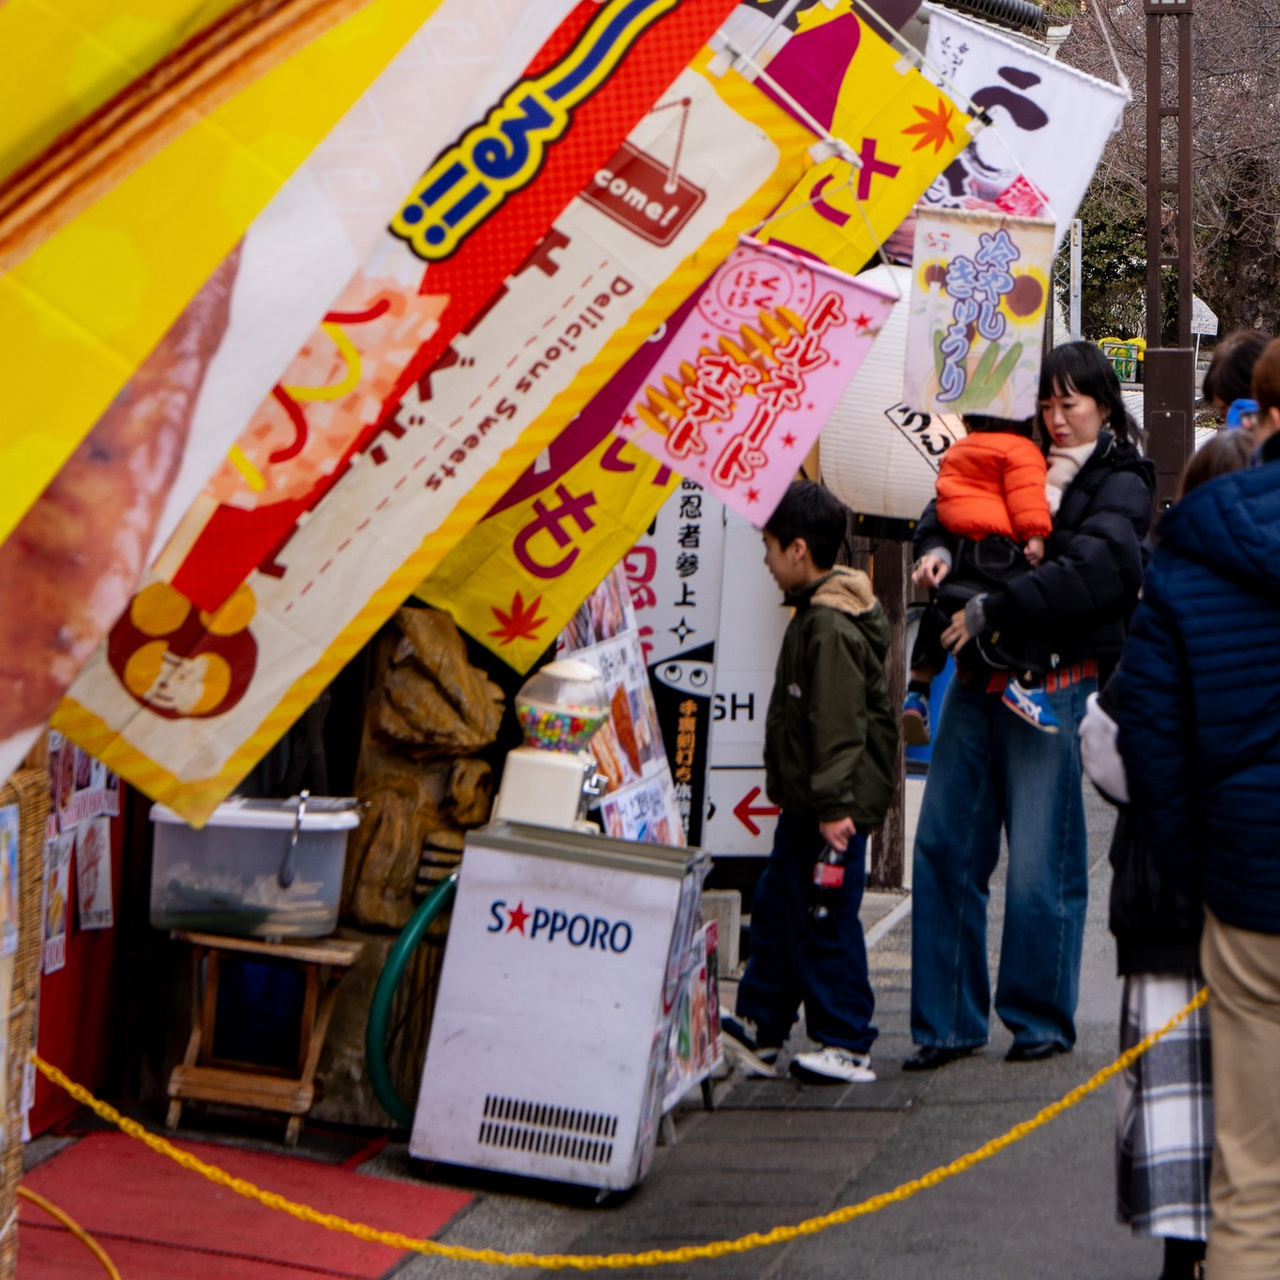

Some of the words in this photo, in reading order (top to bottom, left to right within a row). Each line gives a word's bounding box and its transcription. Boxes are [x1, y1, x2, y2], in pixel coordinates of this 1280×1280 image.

[595, 168, 679, 226] come!
[515, 274, 634, 397] Delicious
[936, 256, 982, 402] きゅうり
[975, 230, 1021, 340] 冷やし
[665, 355, 759, 459] ポテト
[712, 292, 846, 487] トルネード
[897, 406, 950, 466] うど
[424, 397, 519, 493] Sweets
